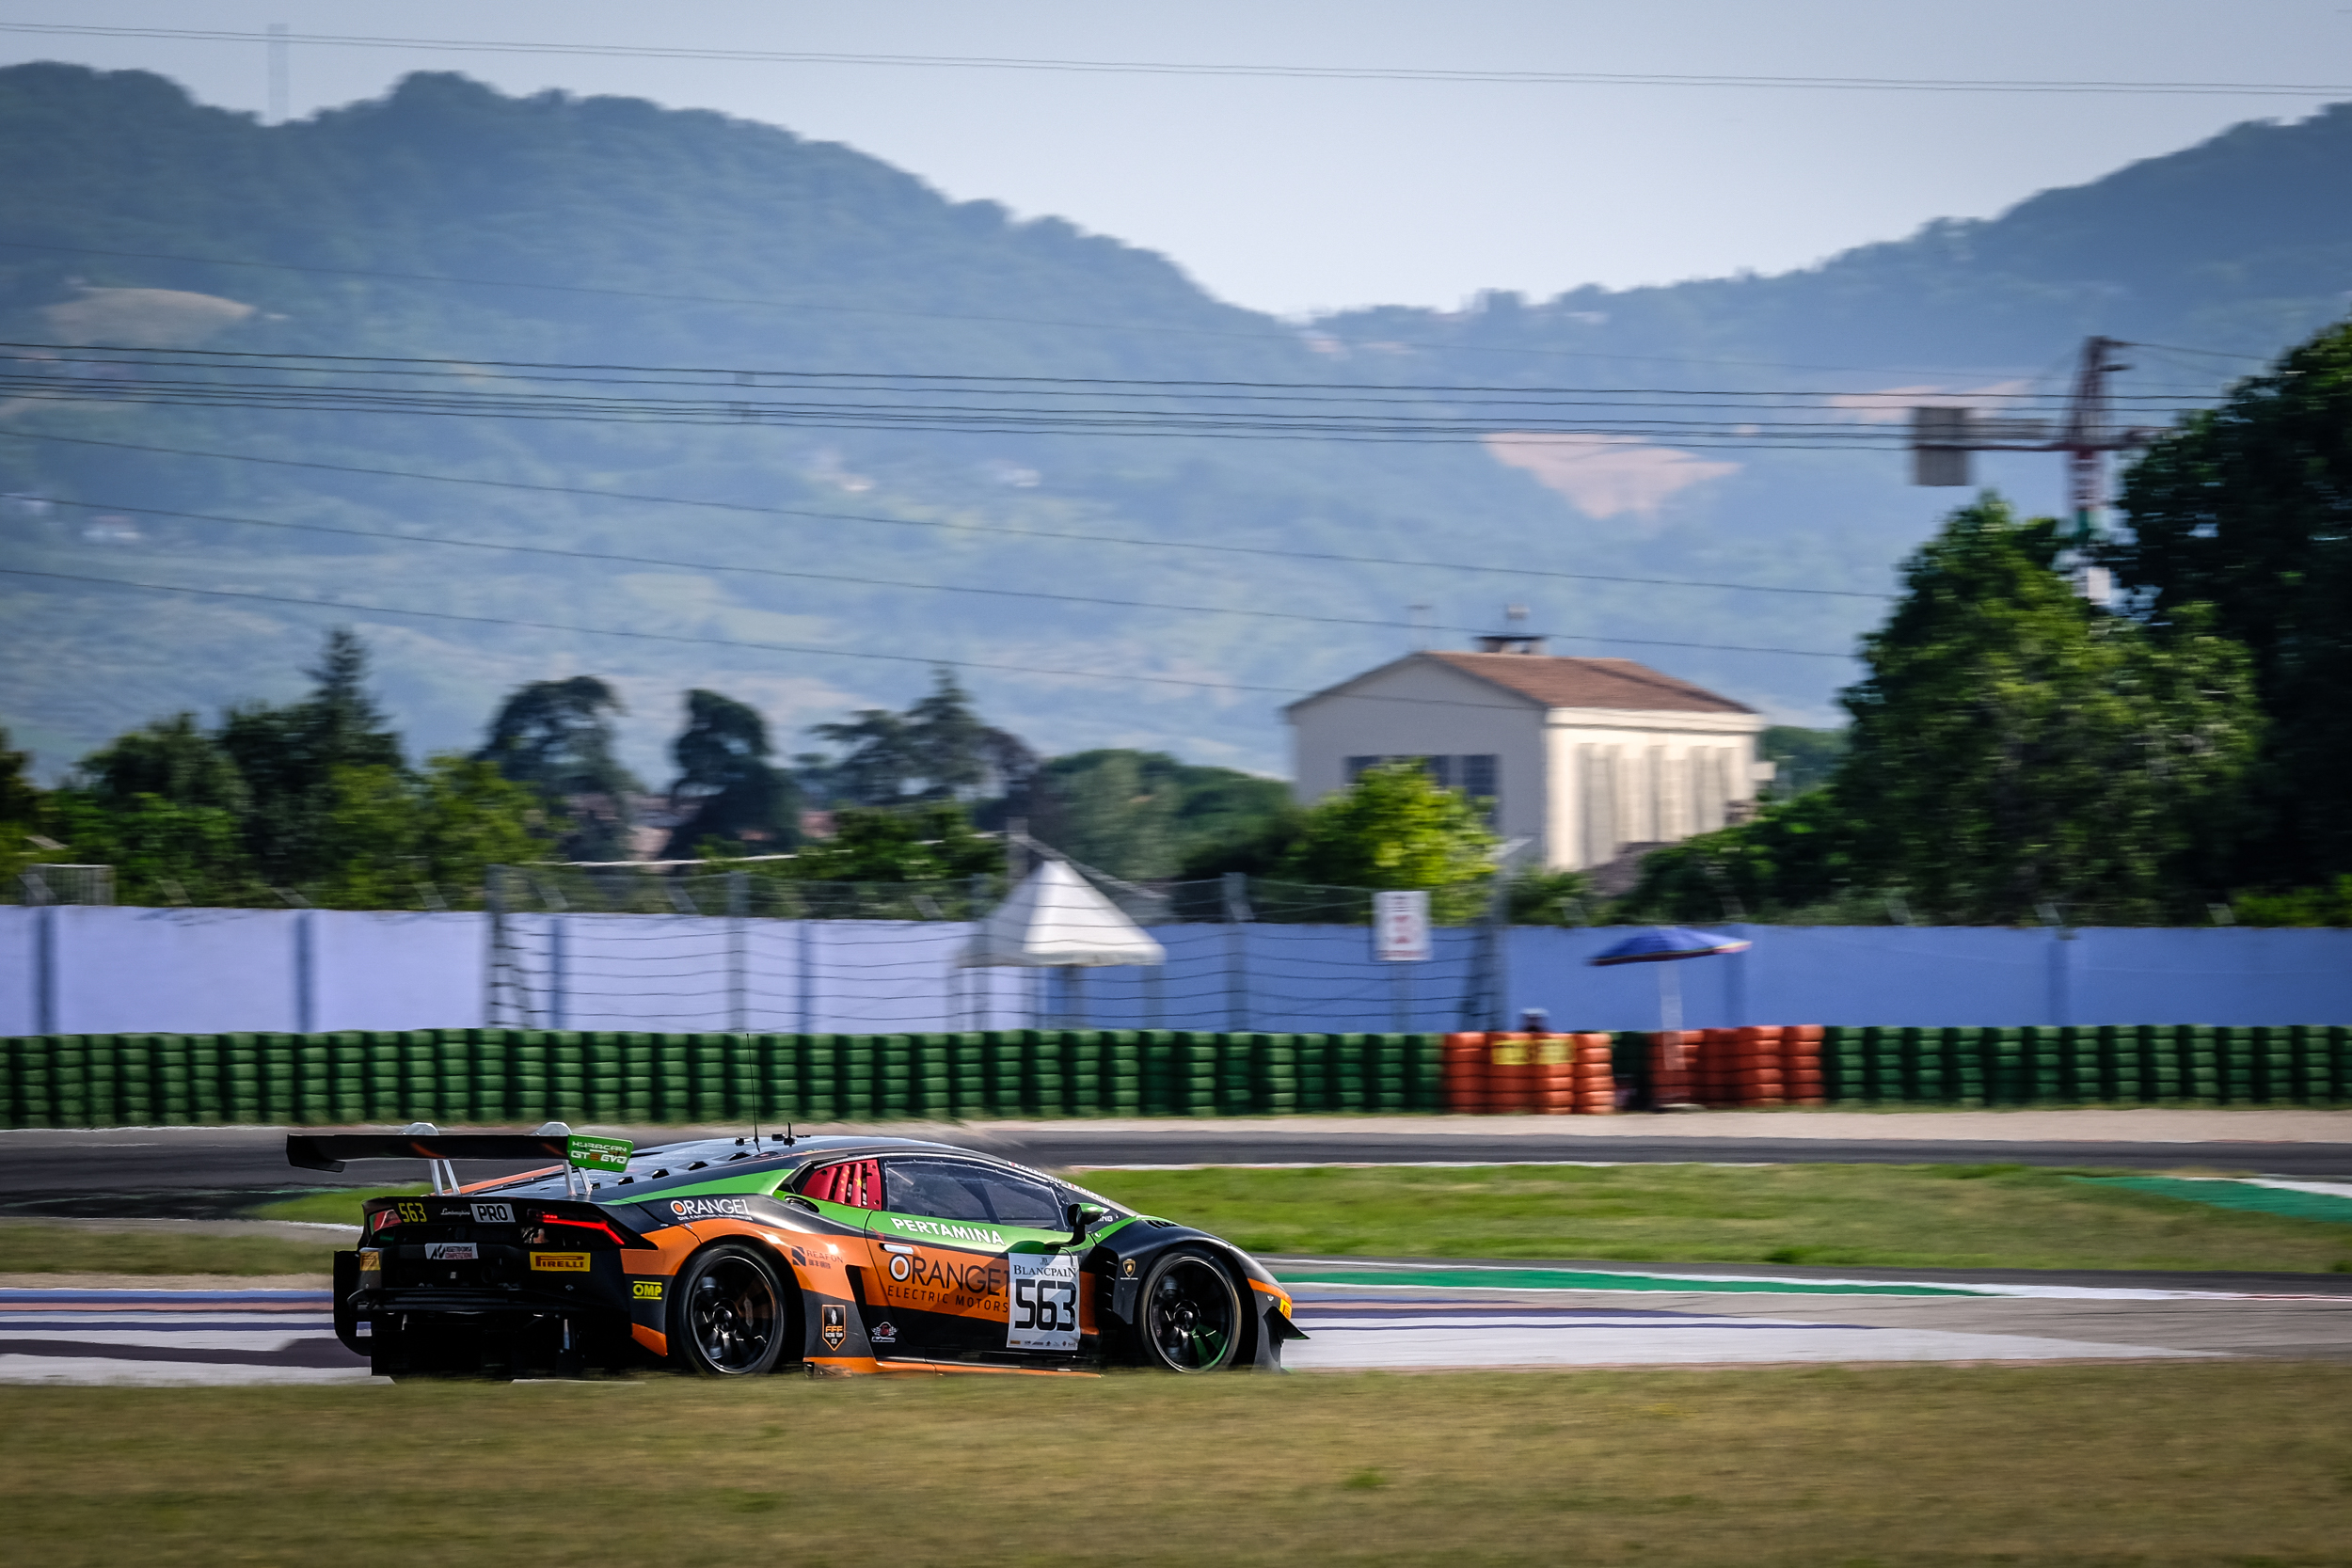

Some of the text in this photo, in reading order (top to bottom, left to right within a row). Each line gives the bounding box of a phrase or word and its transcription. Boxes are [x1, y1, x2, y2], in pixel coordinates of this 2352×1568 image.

[398, 1203, 427, 1223] 563
[477, 1205, 509, 1221] PRO
[670, 1198, 750, 1215] ORANGE1
[890, 1217, 1007, 1246] PERTAMINA
[535, 1255, 585, 1268] PIRELLI
[1013, 1264, 1077, 1278] BLANCPAIN
[633, 1283, 663, 1297] OMP
[887, 1285, 1009, 1314] ELECTRIC MOTORS
[1014, 1278, 1077, 1332] 563
